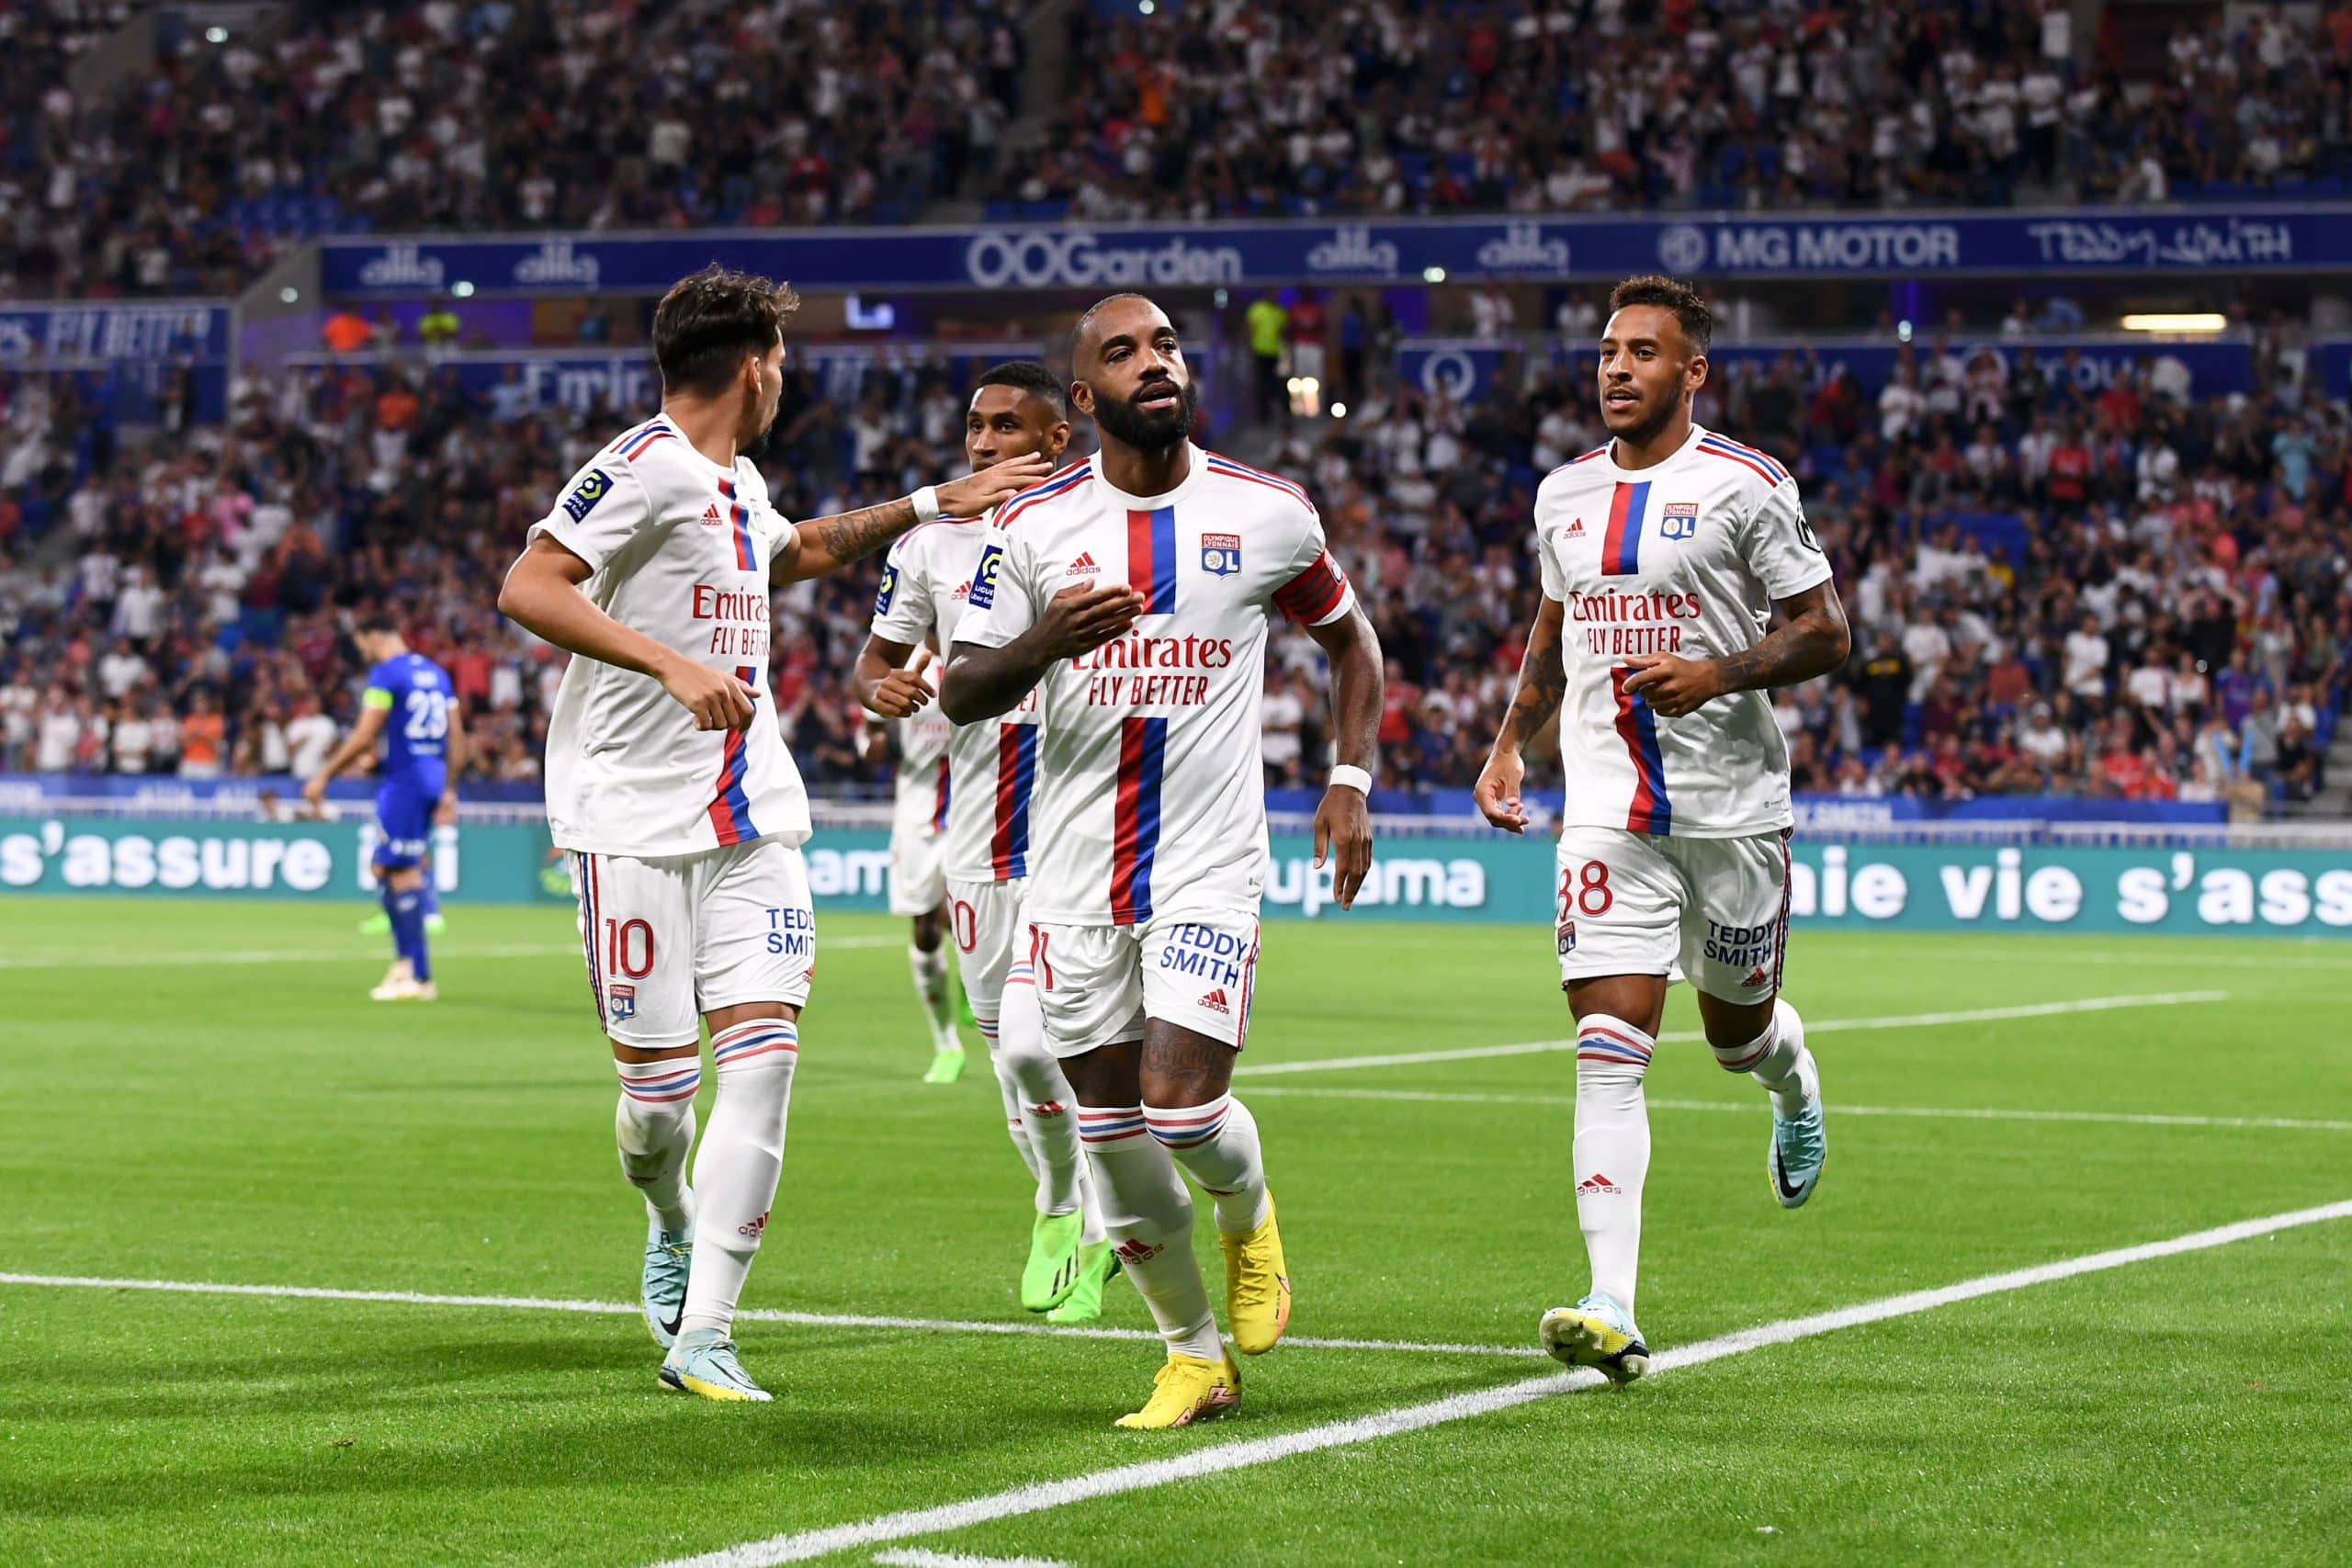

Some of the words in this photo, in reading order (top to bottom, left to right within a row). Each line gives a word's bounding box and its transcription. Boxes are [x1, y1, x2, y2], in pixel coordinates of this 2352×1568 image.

[967, 232, 1241, 287] OOGarden
[1716, 229, 1791, 266] MG
[1796, 228, 1958, 266] MOTOR
[1663, 517, 1692, 536] OL
[1066, 564, 1101, 576] adidas
[1204, 550, 1238, 570] OL
[1568, 588, 1701, 621] Emirates
[710, 626, 736, 654] FLY
[1588, 628, 1606, 654] FLY
[1613, 626, 1680, 654] BETTER
[1089, 677, 1123, 706] FLY
[1130, 676, 1209, 705] BETTER
[2, 822, 333, 892] s'assure
[1264, 857, 1486, 918] upama
[1940, 850, 2083, 921] vie
[951, 897, 977, 953] 0
[1708, 919, 1776, 945] TEDDY
[605, 918, 654, 980] 10
[1703, 940, 1772, 967] SMITH
[1160, 945, 1239, 988] SMITH
[1197, 998, 1230, 1015] adidas
